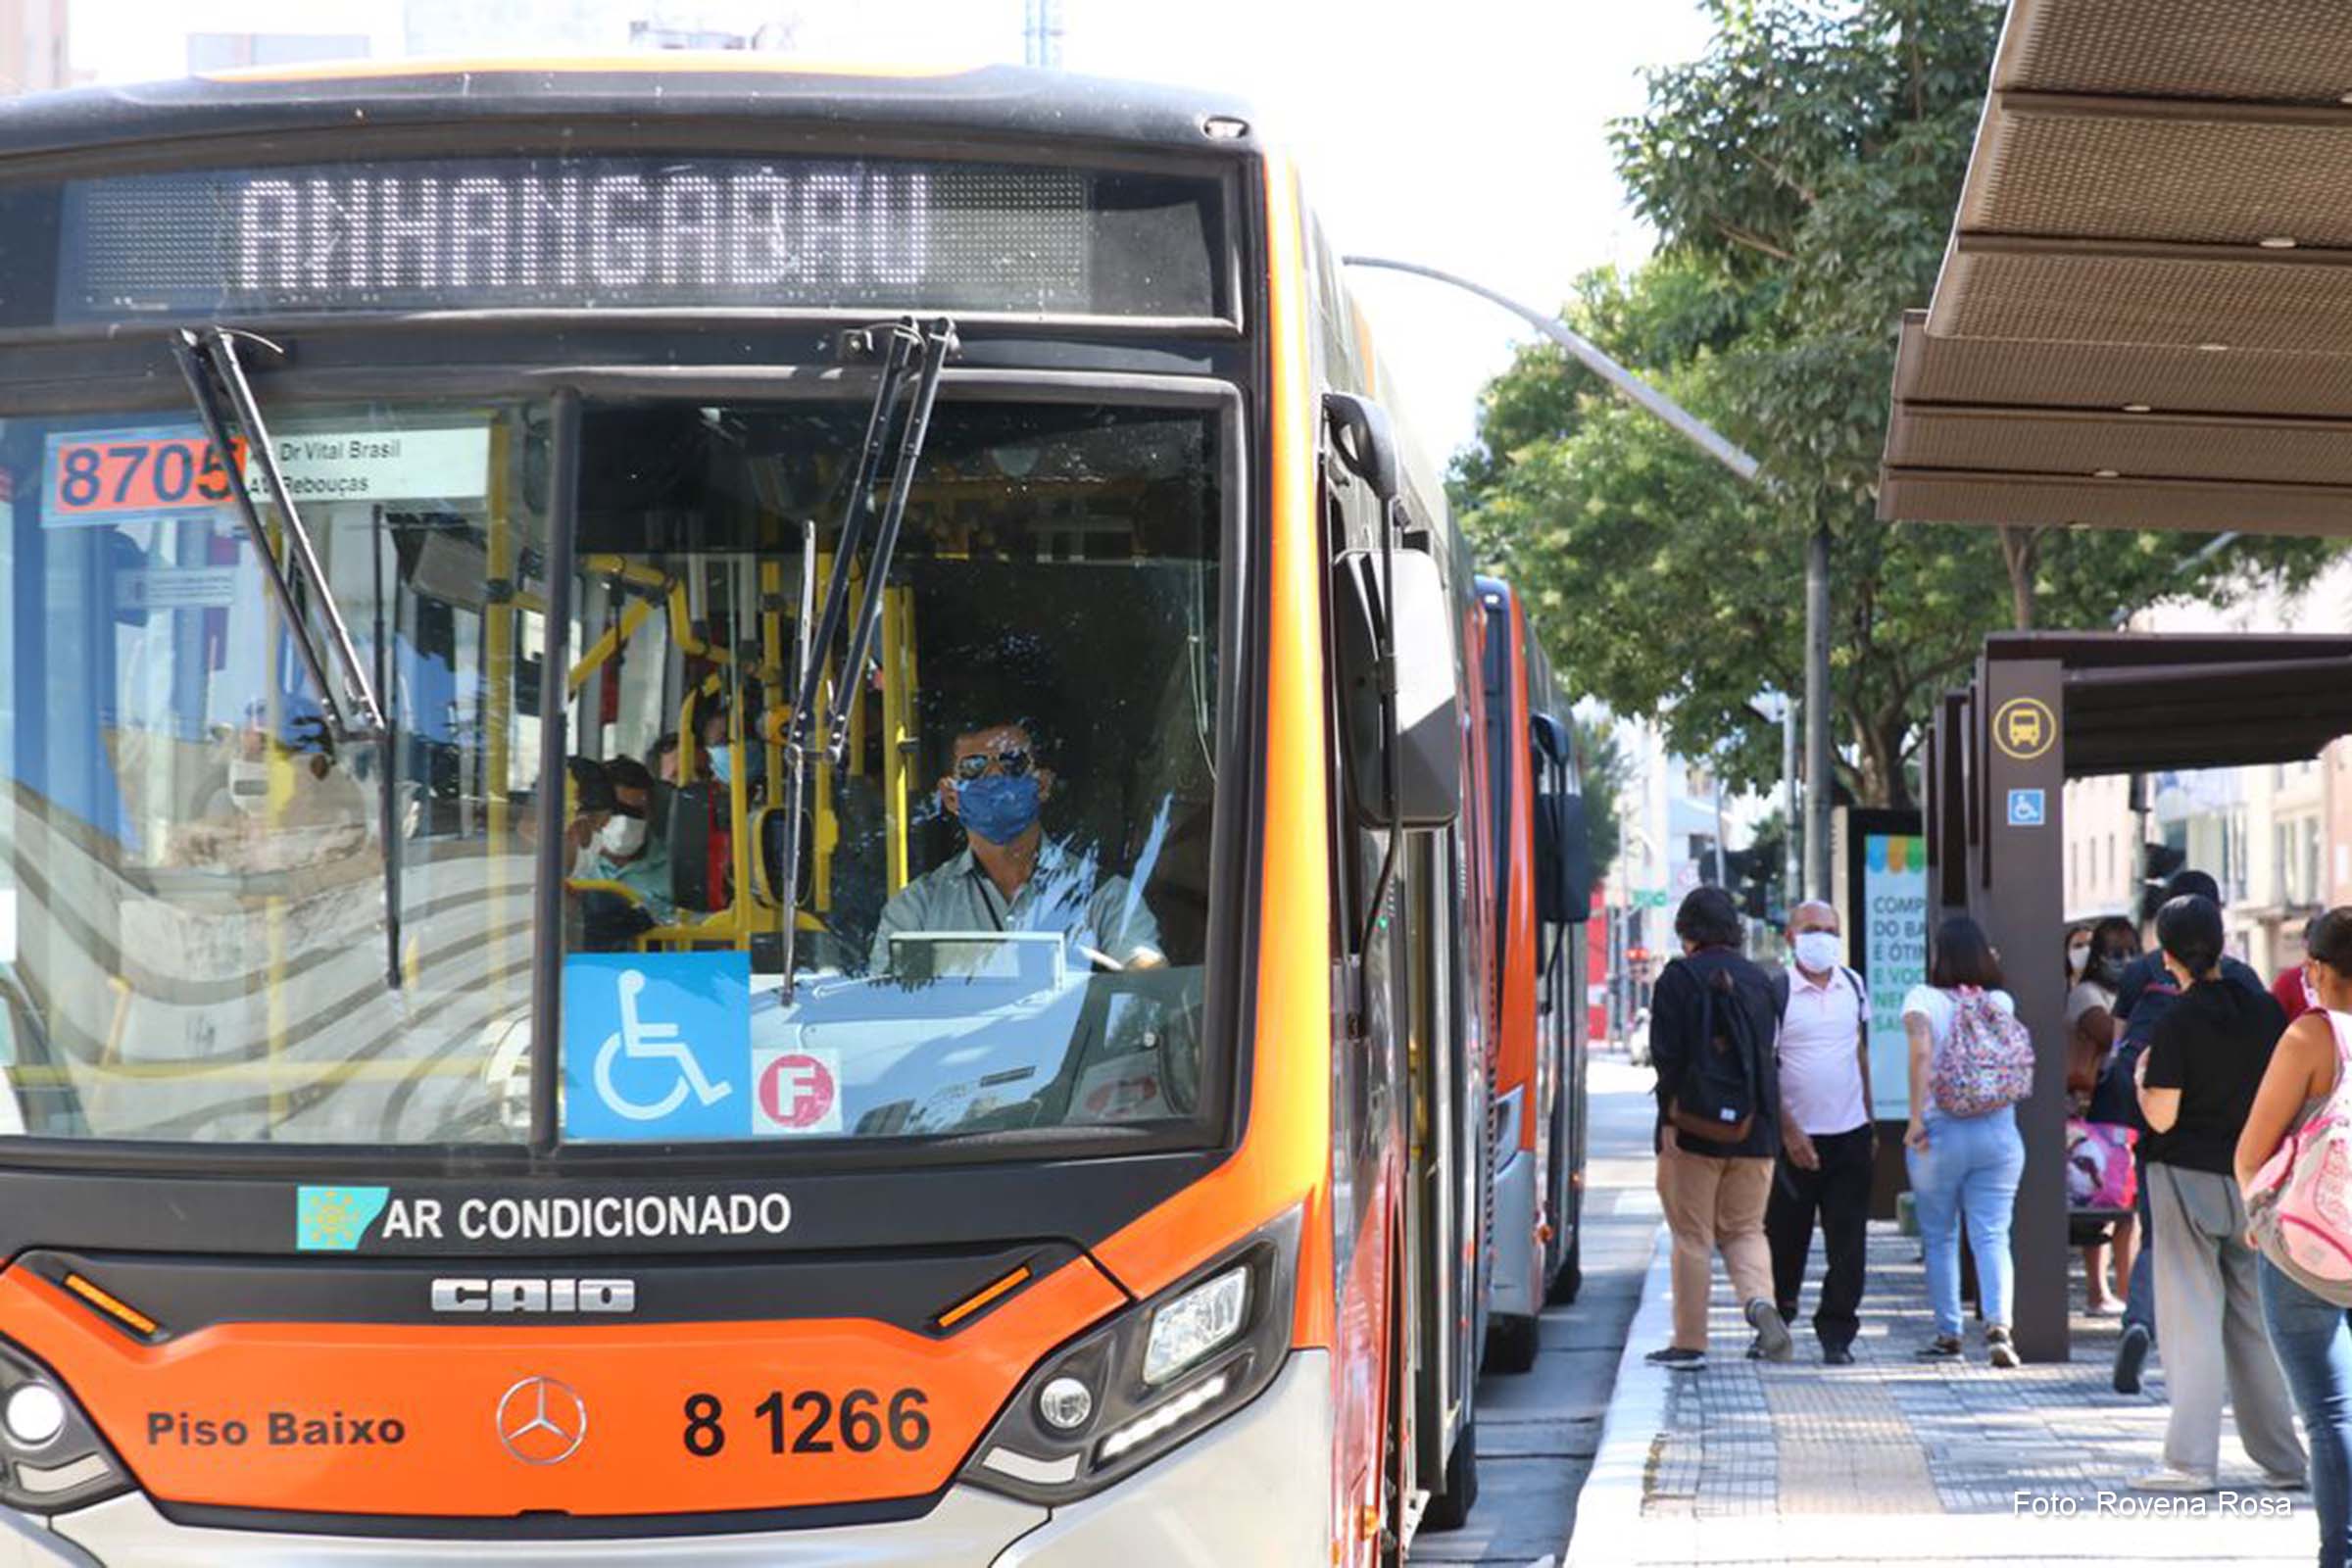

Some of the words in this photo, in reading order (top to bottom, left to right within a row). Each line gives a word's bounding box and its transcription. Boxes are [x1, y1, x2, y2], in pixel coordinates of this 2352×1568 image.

[242, 173, 926, 288] ANHANGABAU
[280, 442, 301, 462] Dr
[306, 440, 344, 461] Vital
[349, 438, 401, 460] Brasil
[62, 442, 238, 507] 8705
[1873, 919, 1899, 938] DO
[777, 1067, 815, 1116] F
[382, 1199, 444, 1239] AR
[458, 1192, 792, 1239] CONDICIONADO
[431, 1278, 636, 1312] CAIO
[147, 1412, 249, 1446] Piso
[268, 1411, 407, 1446] Baixo
[683, 1393, 726, 1457] 8
[755, 1387, 931, 1453] 1266
